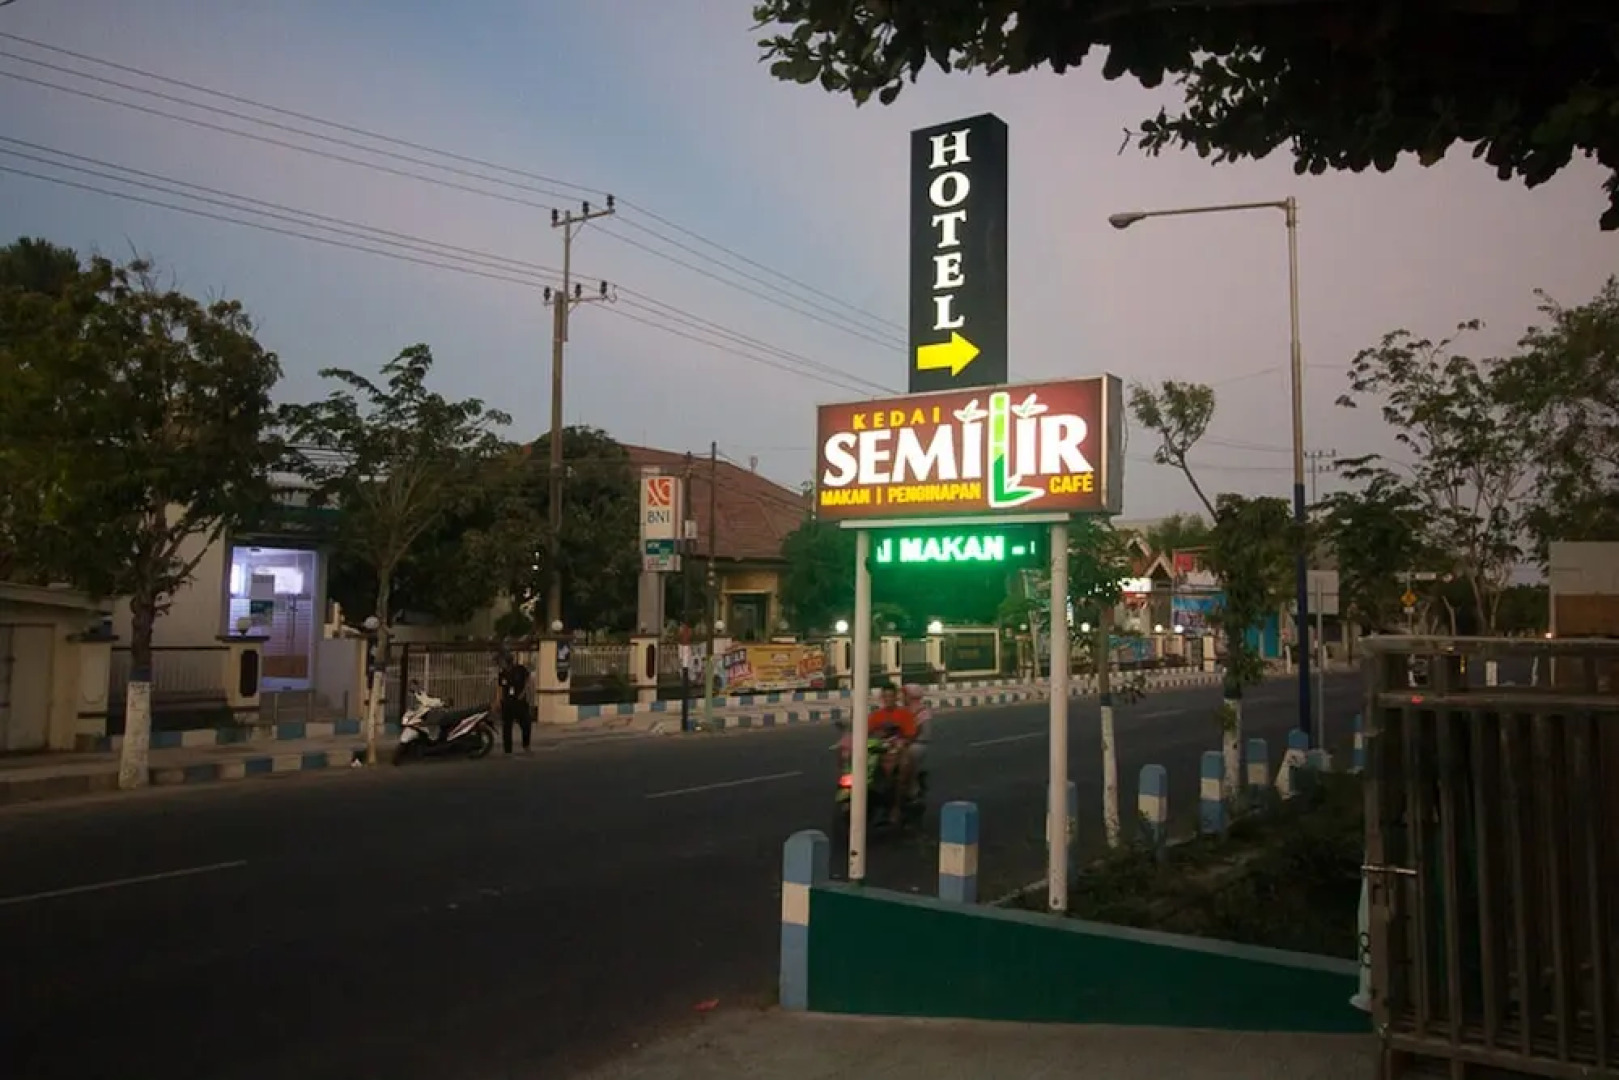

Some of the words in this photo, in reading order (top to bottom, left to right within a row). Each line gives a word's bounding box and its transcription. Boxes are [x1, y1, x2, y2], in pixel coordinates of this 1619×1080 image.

[929, 129, 971, 330] HOTEL
[854, 406, 940, 429] KEDAI
[823, 392, 1095, 508] SEMILIR
[821, 488, 870, 506] MAKAN
[888, 482, 982, 503] PENGINAPAN
[1049, 471, 1094, 494] CAFÉ
[647, 510, 670, 523] BNI
[900, 535, 1005, 562] MAKAN
